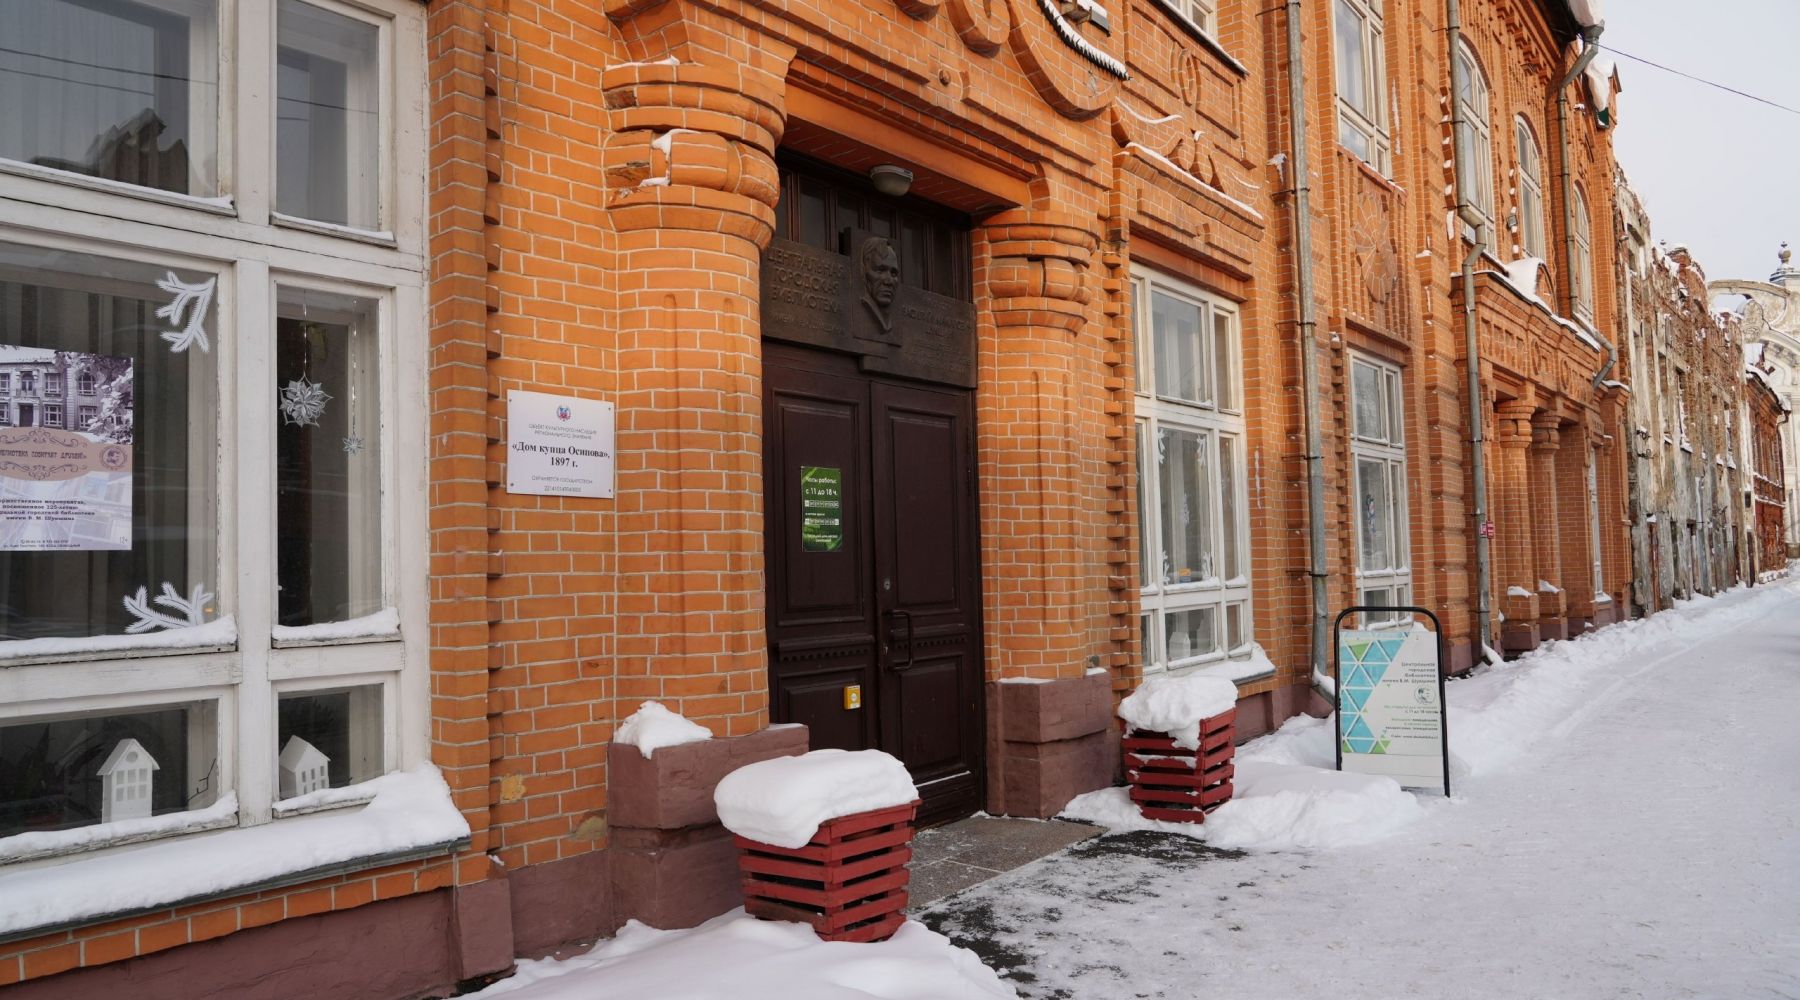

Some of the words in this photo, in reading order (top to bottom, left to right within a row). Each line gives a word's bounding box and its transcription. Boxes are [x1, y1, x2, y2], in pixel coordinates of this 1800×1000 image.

[772, 265, 841, 297] ГОРОДСКАЯ
[770, 284, 841, 315] БИБЛИОТЕКА
[512, 441, 537, 452] «Дом
[539, 445, 566, 455] купца
[568, 445, 610, 459] Осипова»,
[551, 457, 570, 467] 1897
[572, 460, 578, 468] г.
[810, 487, 817, 495] 11
[826, 488, 833, 496] 18
